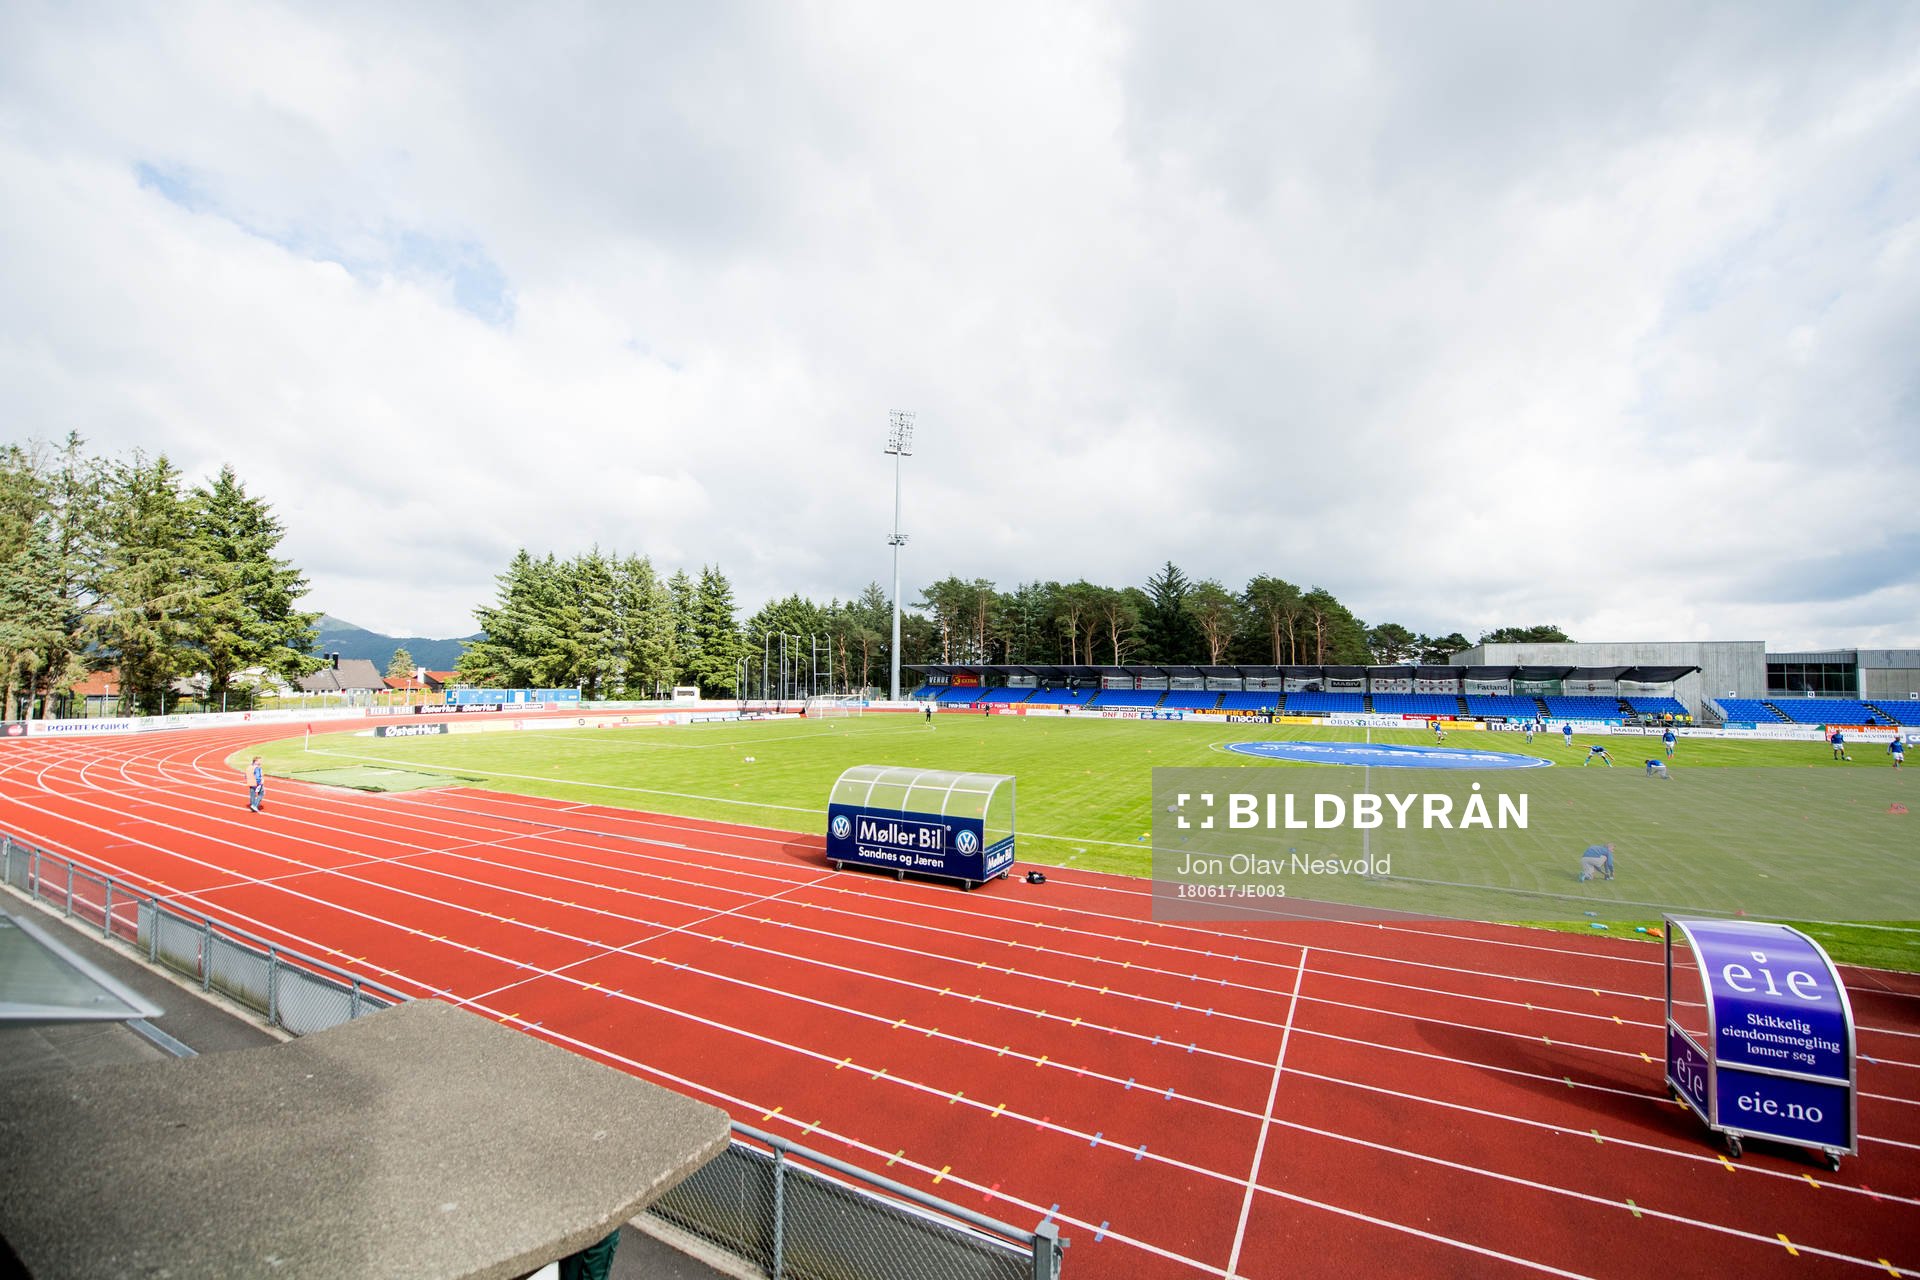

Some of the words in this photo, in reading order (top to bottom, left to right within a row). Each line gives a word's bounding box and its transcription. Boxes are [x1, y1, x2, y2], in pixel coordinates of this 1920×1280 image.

[1476, 683, 1508, 691] Fatland
[1102, 711, 1117, 719] DNF
[1230, 715, 1269, 724] macron
[385, 724, 441, 737] ØsterHus
[1491, 723, 1542, 732] macrn
[859, 821, 916, 847] Møller
[919, 828, 942, 850] Bil
[858, 846, 898, 862] Sandnes
[899, 854, 912, 866] og
[913, 854, 944, 868] Jæren
[1722, 951, 1822, 1001] eie
[1747, 1013, 1811, 1035] Skikkelig
[1722, 1026, 1841, 1053] eiendomsmegling
[1747, 1042, 1789, 1059] lønner
[1792, 1051, 1816, 1065] seg
[1676, 1050, 1704, 1102] eie
[1737, 1091, 1823, 1124] eie.no
